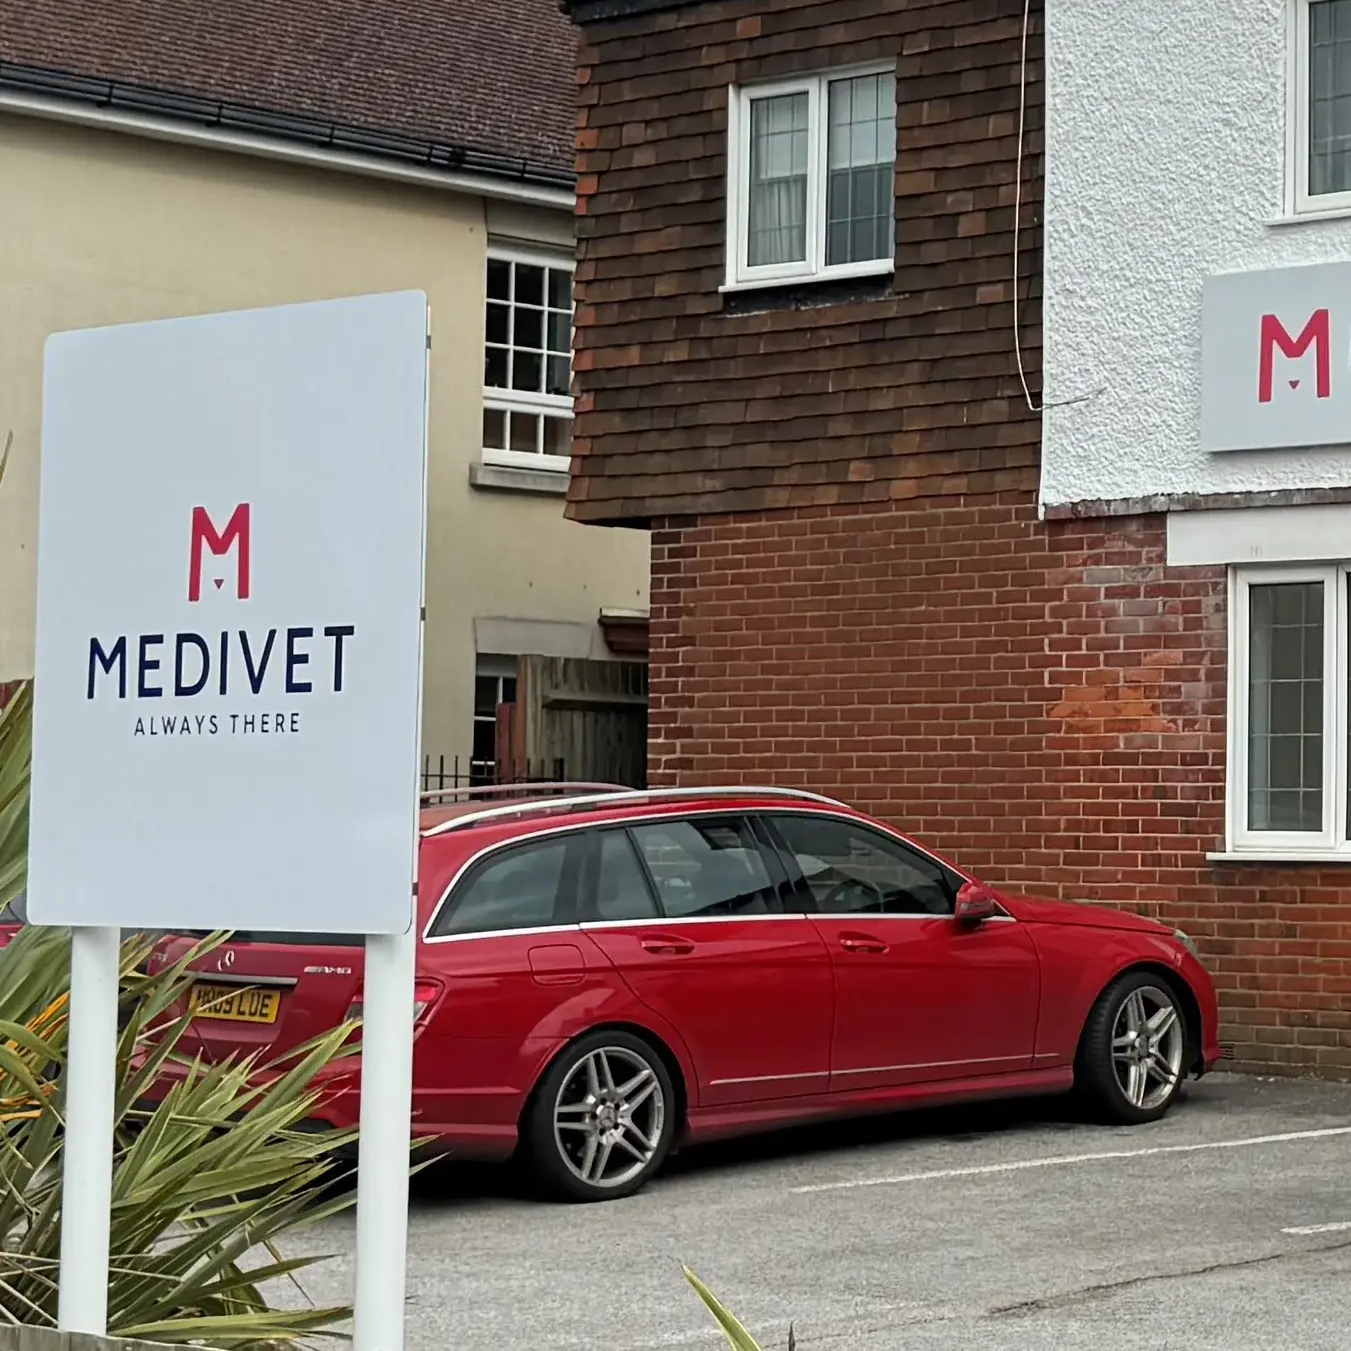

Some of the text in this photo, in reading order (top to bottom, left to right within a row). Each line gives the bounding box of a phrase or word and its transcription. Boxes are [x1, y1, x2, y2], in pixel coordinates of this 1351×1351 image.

[87, 625, 355, 700] MEDIVET
[134, 712, 300, 736] ALWAYS THERE
